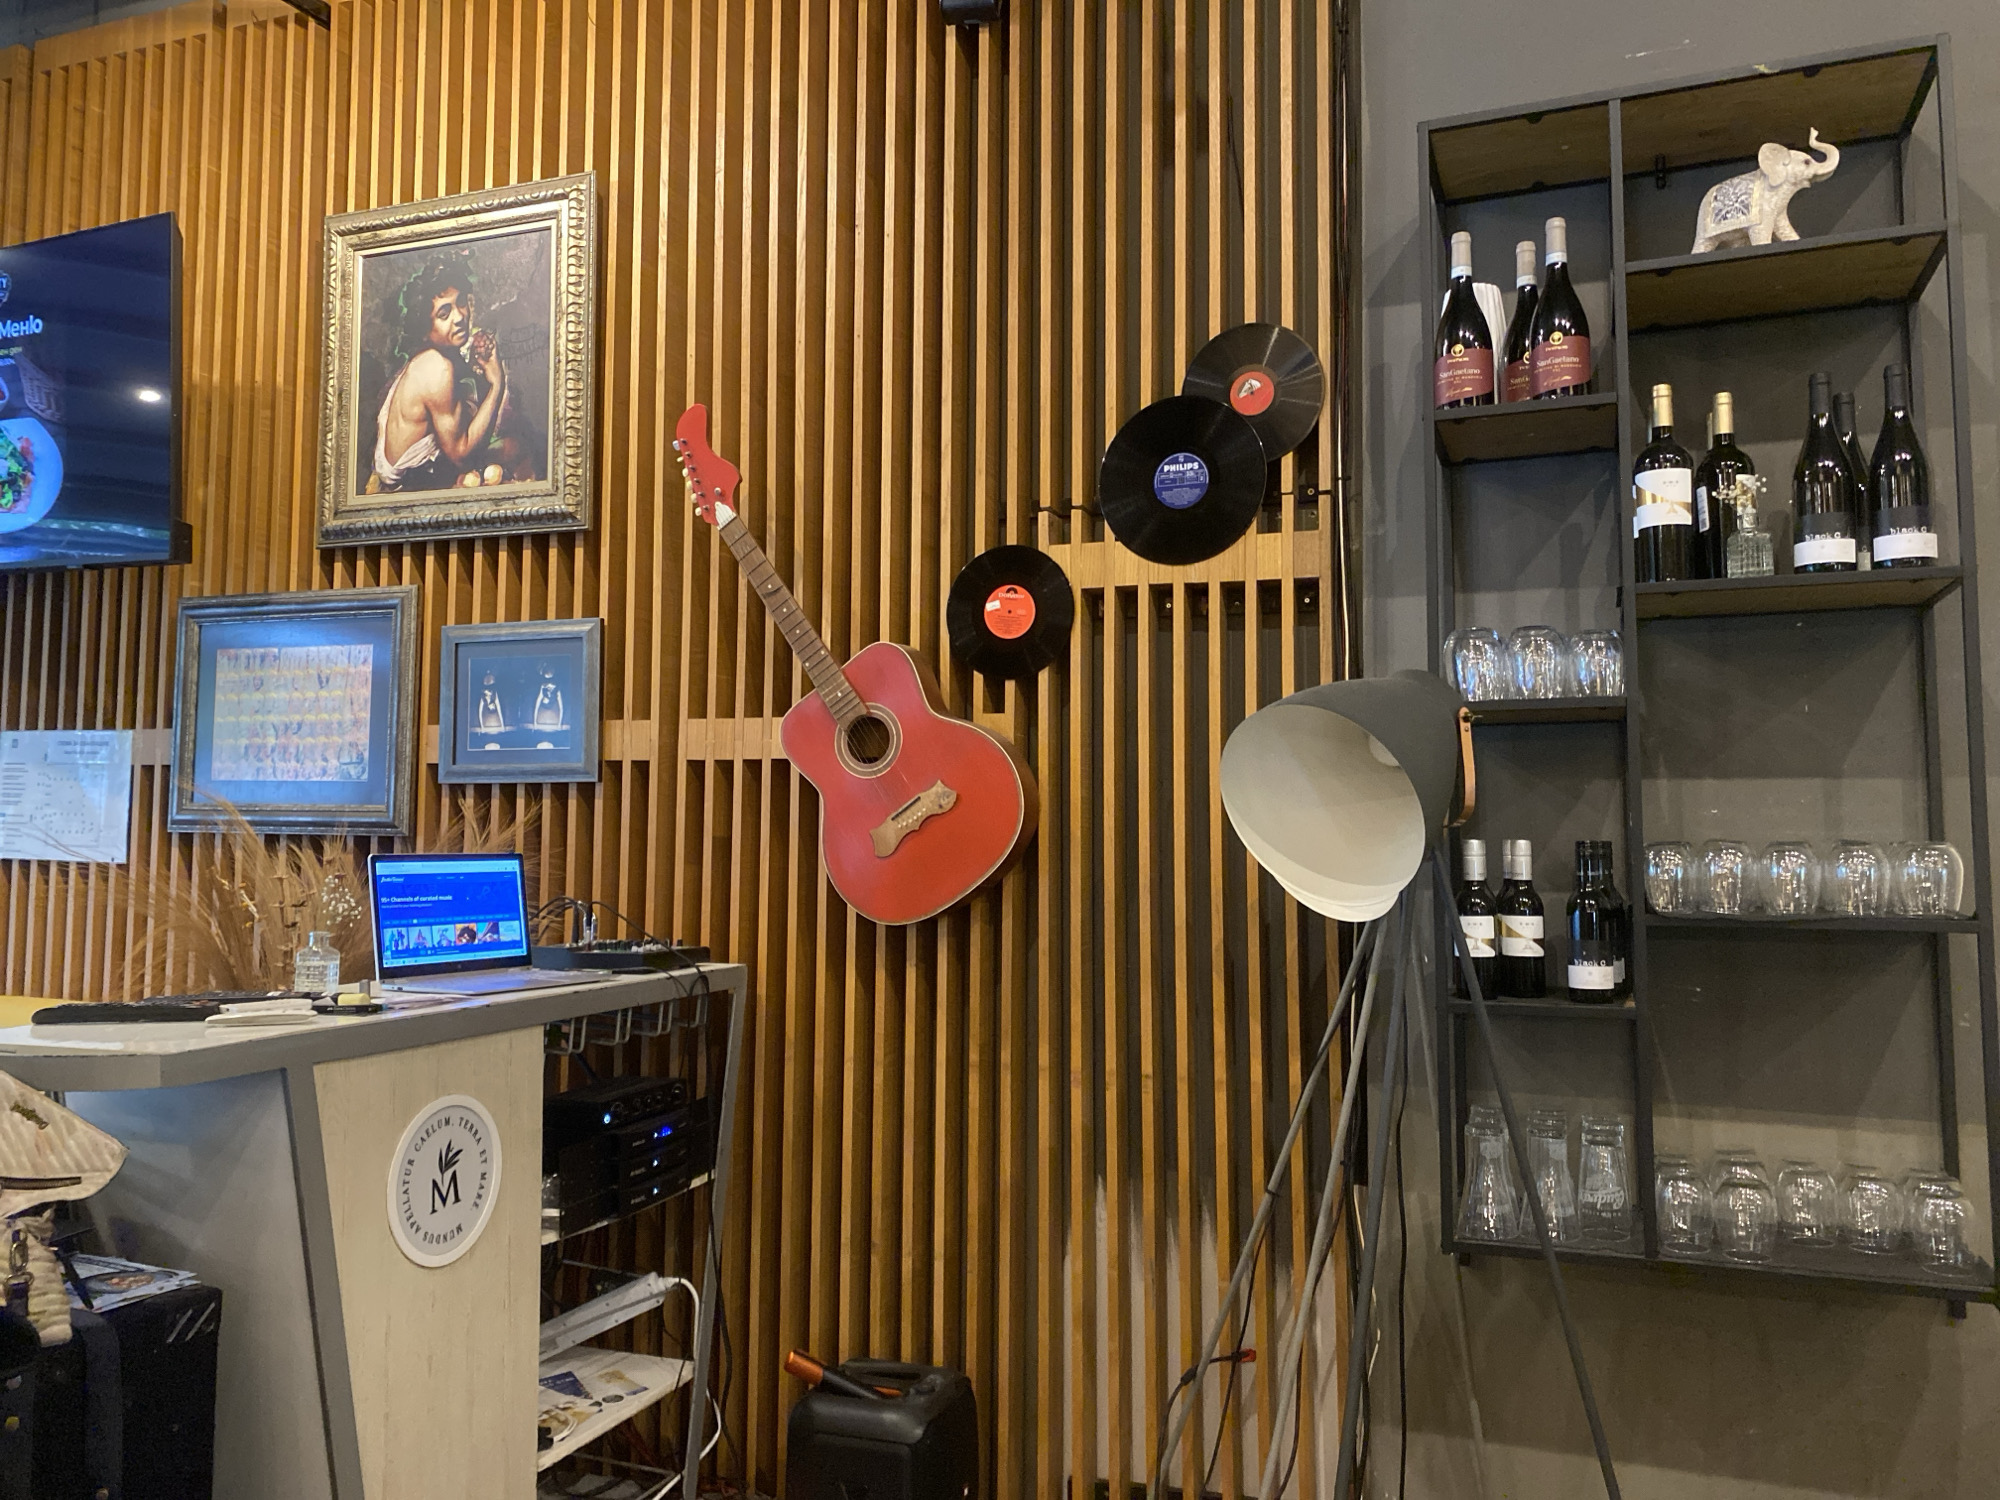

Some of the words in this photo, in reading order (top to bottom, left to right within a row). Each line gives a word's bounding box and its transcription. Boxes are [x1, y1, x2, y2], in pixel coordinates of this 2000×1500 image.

[0, 314, 43, 339] Меню
[1164, 462, 1199, 472] PHILIPS
[459, 1116, 482, 1146] TERRA
[479, 1149, 488, 1165] ET
[402, 1158, 422, 1235] APELLATUR
[429, 1168, 462, 1215] M
[422, 1223, 464, 1245] MUNDUS
